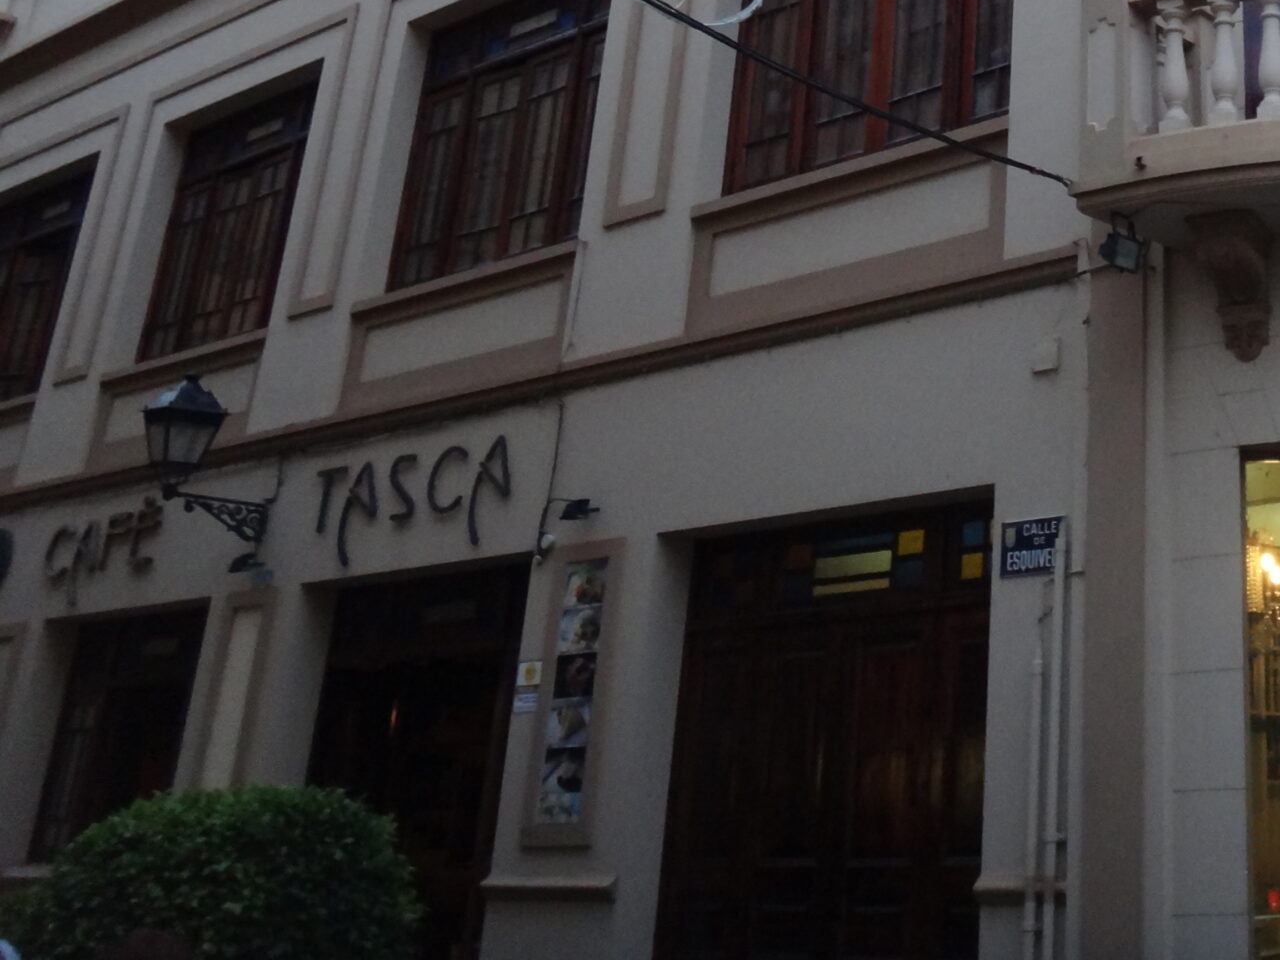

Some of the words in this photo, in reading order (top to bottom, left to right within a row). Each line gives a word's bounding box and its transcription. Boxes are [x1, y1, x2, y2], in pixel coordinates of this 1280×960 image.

[316, 435, 511, 567] TASCA
[1023, 521, 1057, 536] CALLE
[1033, 536, 1046, 545] DE
